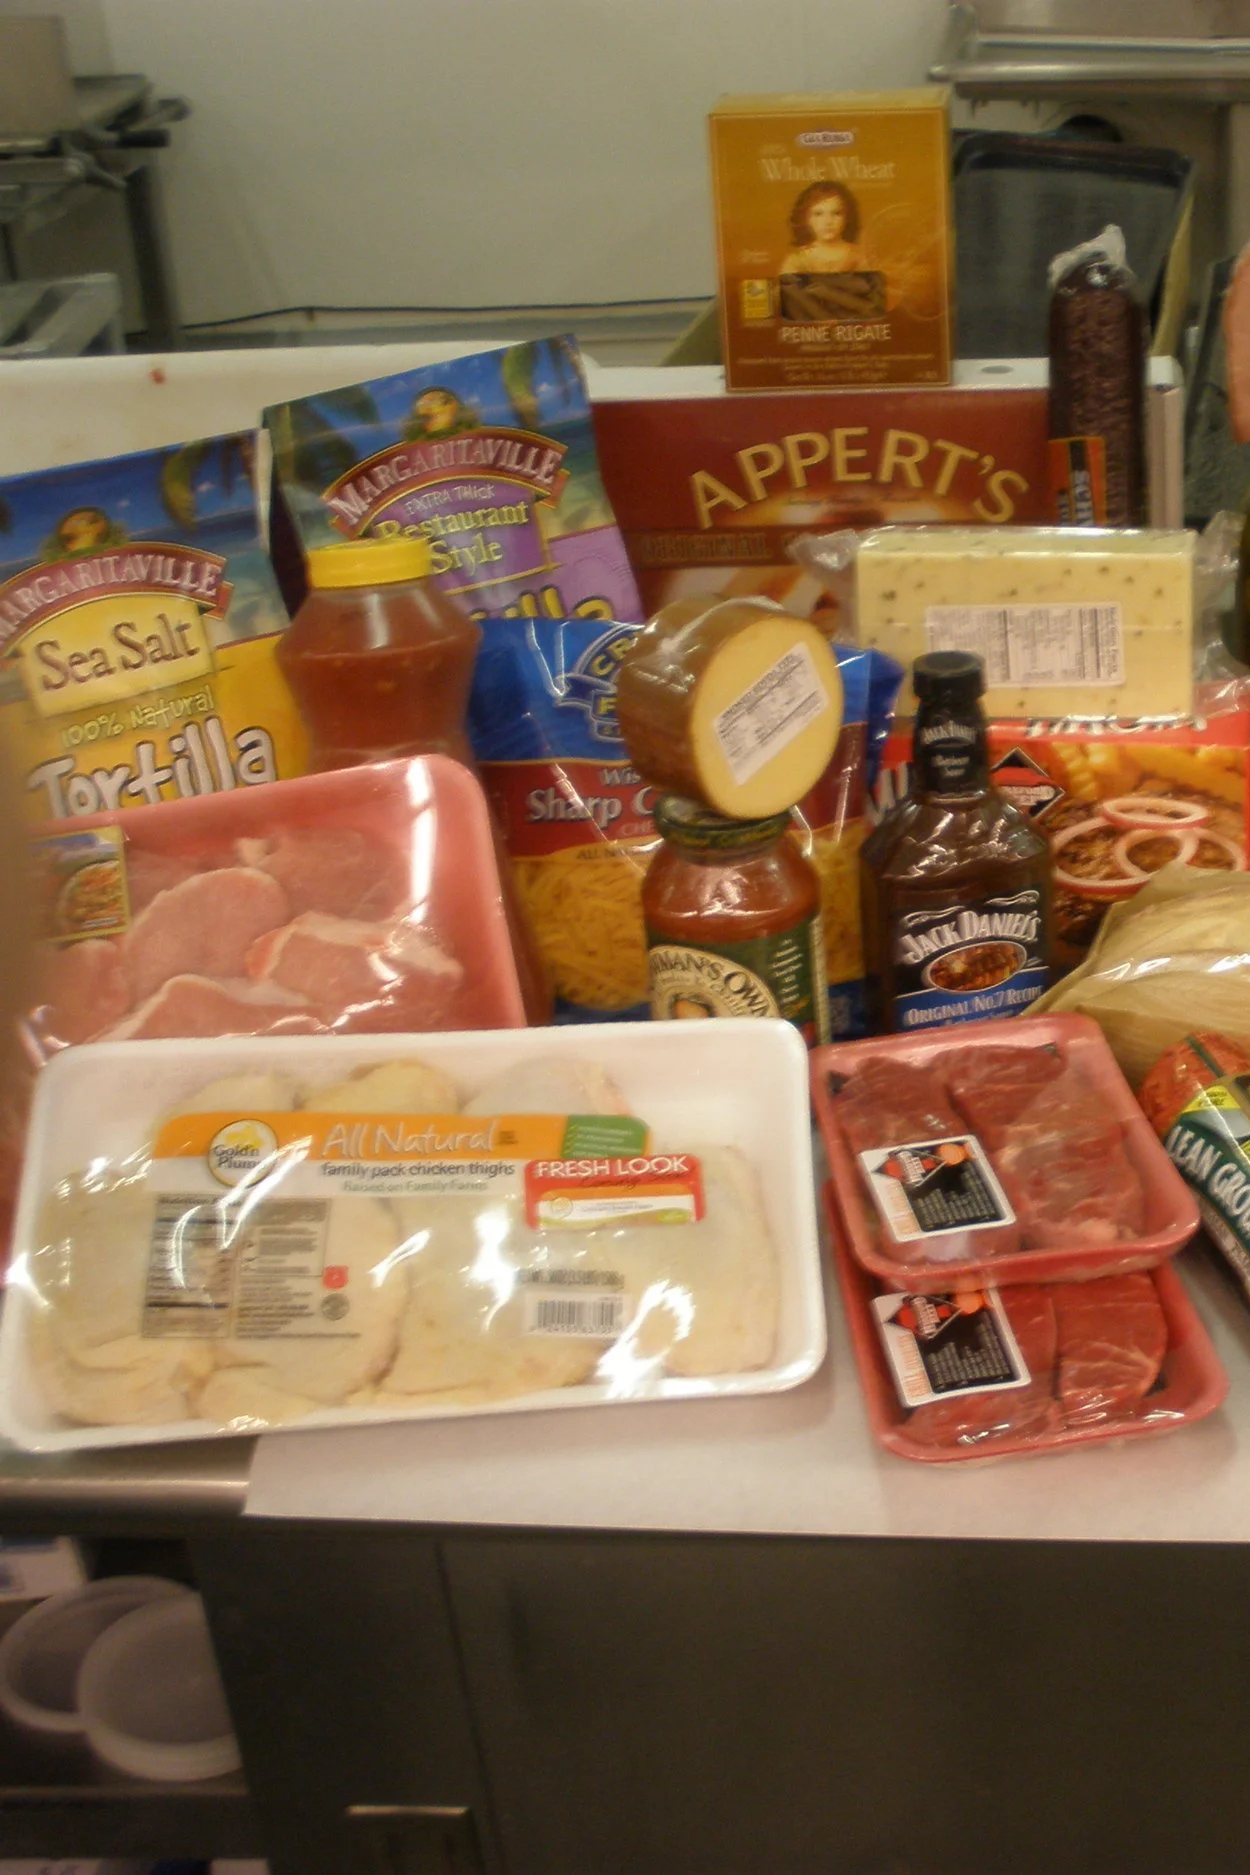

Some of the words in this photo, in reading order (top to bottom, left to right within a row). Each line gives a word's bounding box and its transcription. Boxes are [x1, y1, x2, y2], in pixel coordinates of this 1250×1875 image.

[829, 156, 896, 179] Wheat
[782, 325, 830, 343] PENNE
[836, 323, 892, 340] RIGATE
[326, 438, 564, 526] MARGARITAVILLE
[690, 427, 1029, 529] APPERT'S
[375, 501, 529, 541] Restaurant
[405, 490, 452, 517] EXTRA
[427, 532, 503, 577] Style
[35, 640, 116, 690] Sea
[113, 612, 200, 671] Salt
[60, 713, 125, 748] 100%
[131, 685, 215, 729] Natural
[26, 715, 277, 819] Tortilla
[526, 786, 622, 829] Sharp
[901, 921, 962, 964] JACK
[905, 1001, 971, 1025] ORIGINAL
[321, 1122, 369, 1158] All
[374, 1120, 498, 1153] Natural
[1162, 1125, 1221, 1182] LEAN
[321, 1161, 368, 1178] family
[372, 1163, 405, 1179] pack
[408, 1160, 466, 1175] chicken
[468, 1160, 515, 1179] thighs
[537, 1160, 609, 1177] FRESH
[617, 1156, 689, 1175] LOOK
